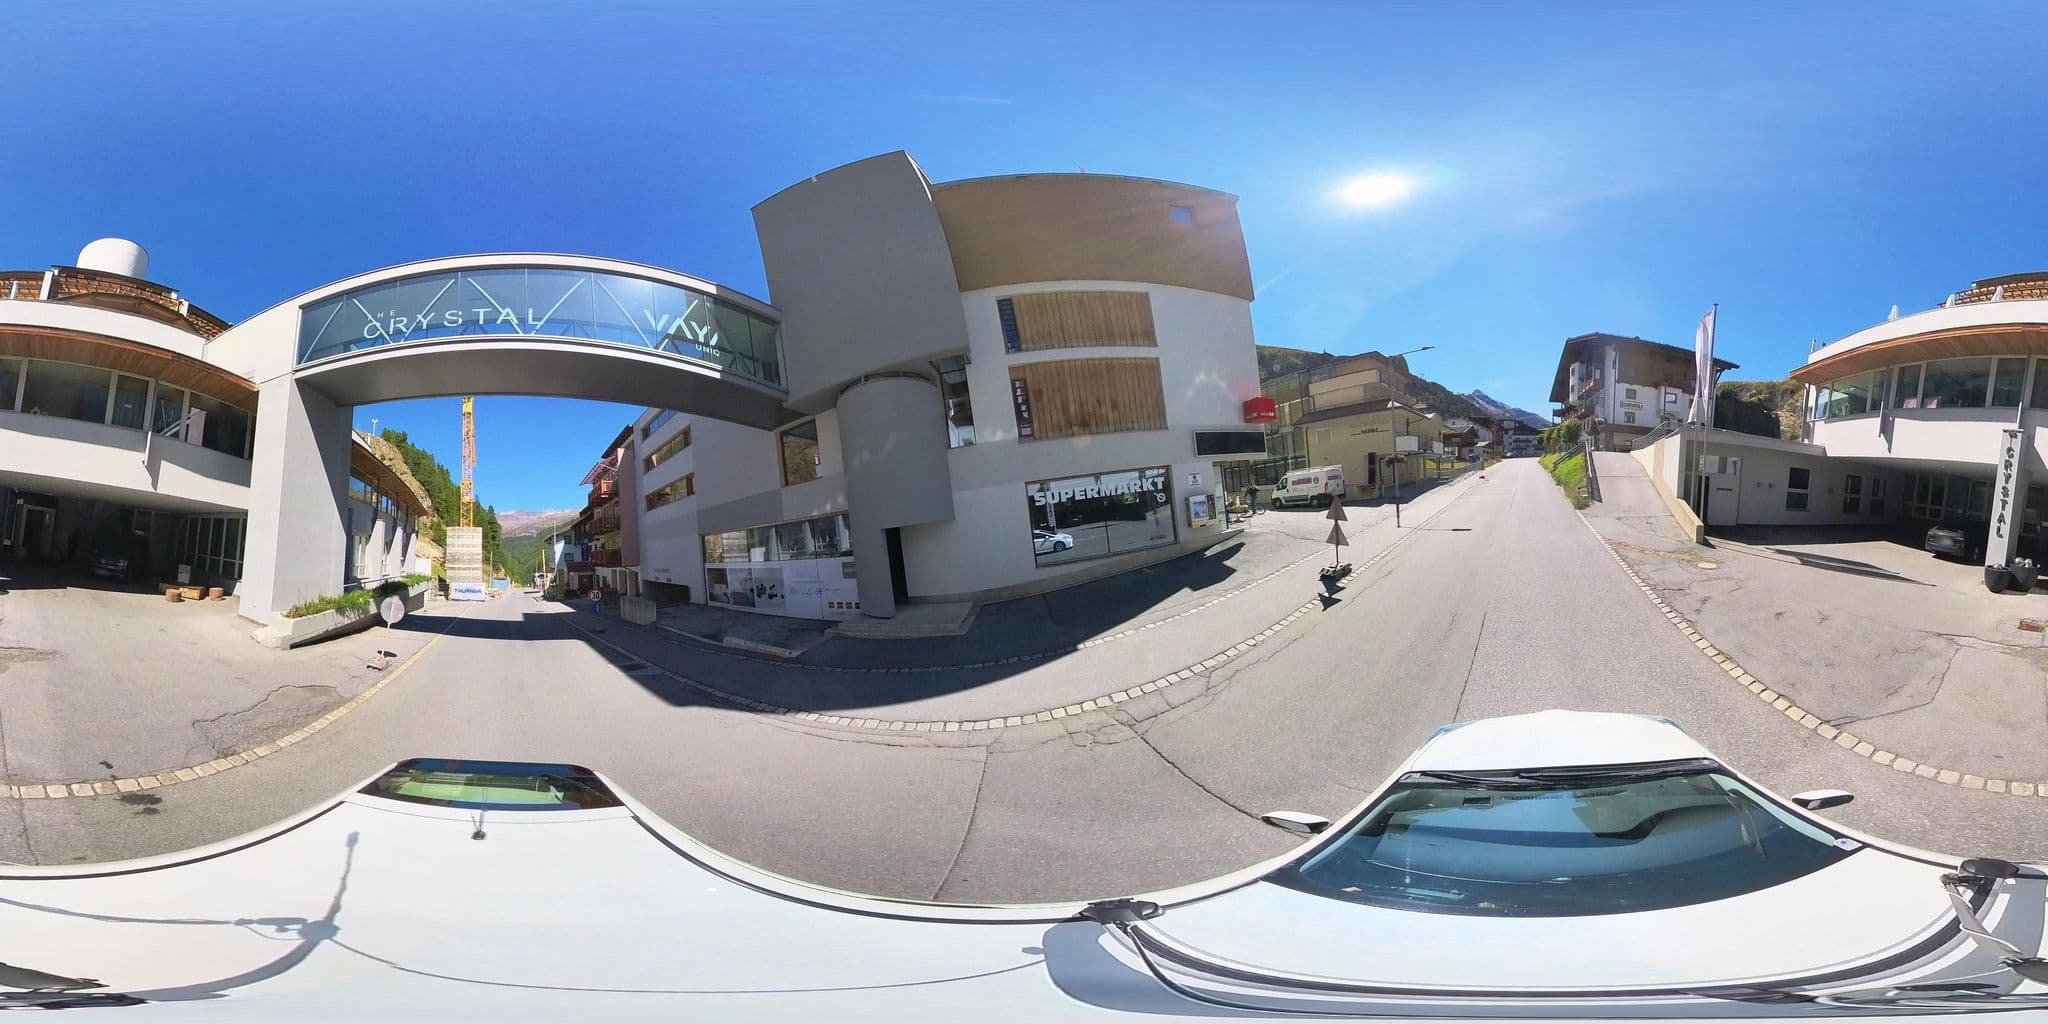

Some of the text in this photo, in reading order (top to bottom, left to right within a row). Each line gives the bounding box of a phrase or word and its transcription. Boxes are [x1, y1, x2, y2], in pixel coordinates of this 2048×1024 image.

[363, 308, 545, 339] CRYSTAL
[696, 344, 720, 357] UNIQ
[1033, 477, 1165, 506] SUPERMARKT
[1996, 446, 2015, 539] CRYSTAL
[591, 591, 600, 600] 30
